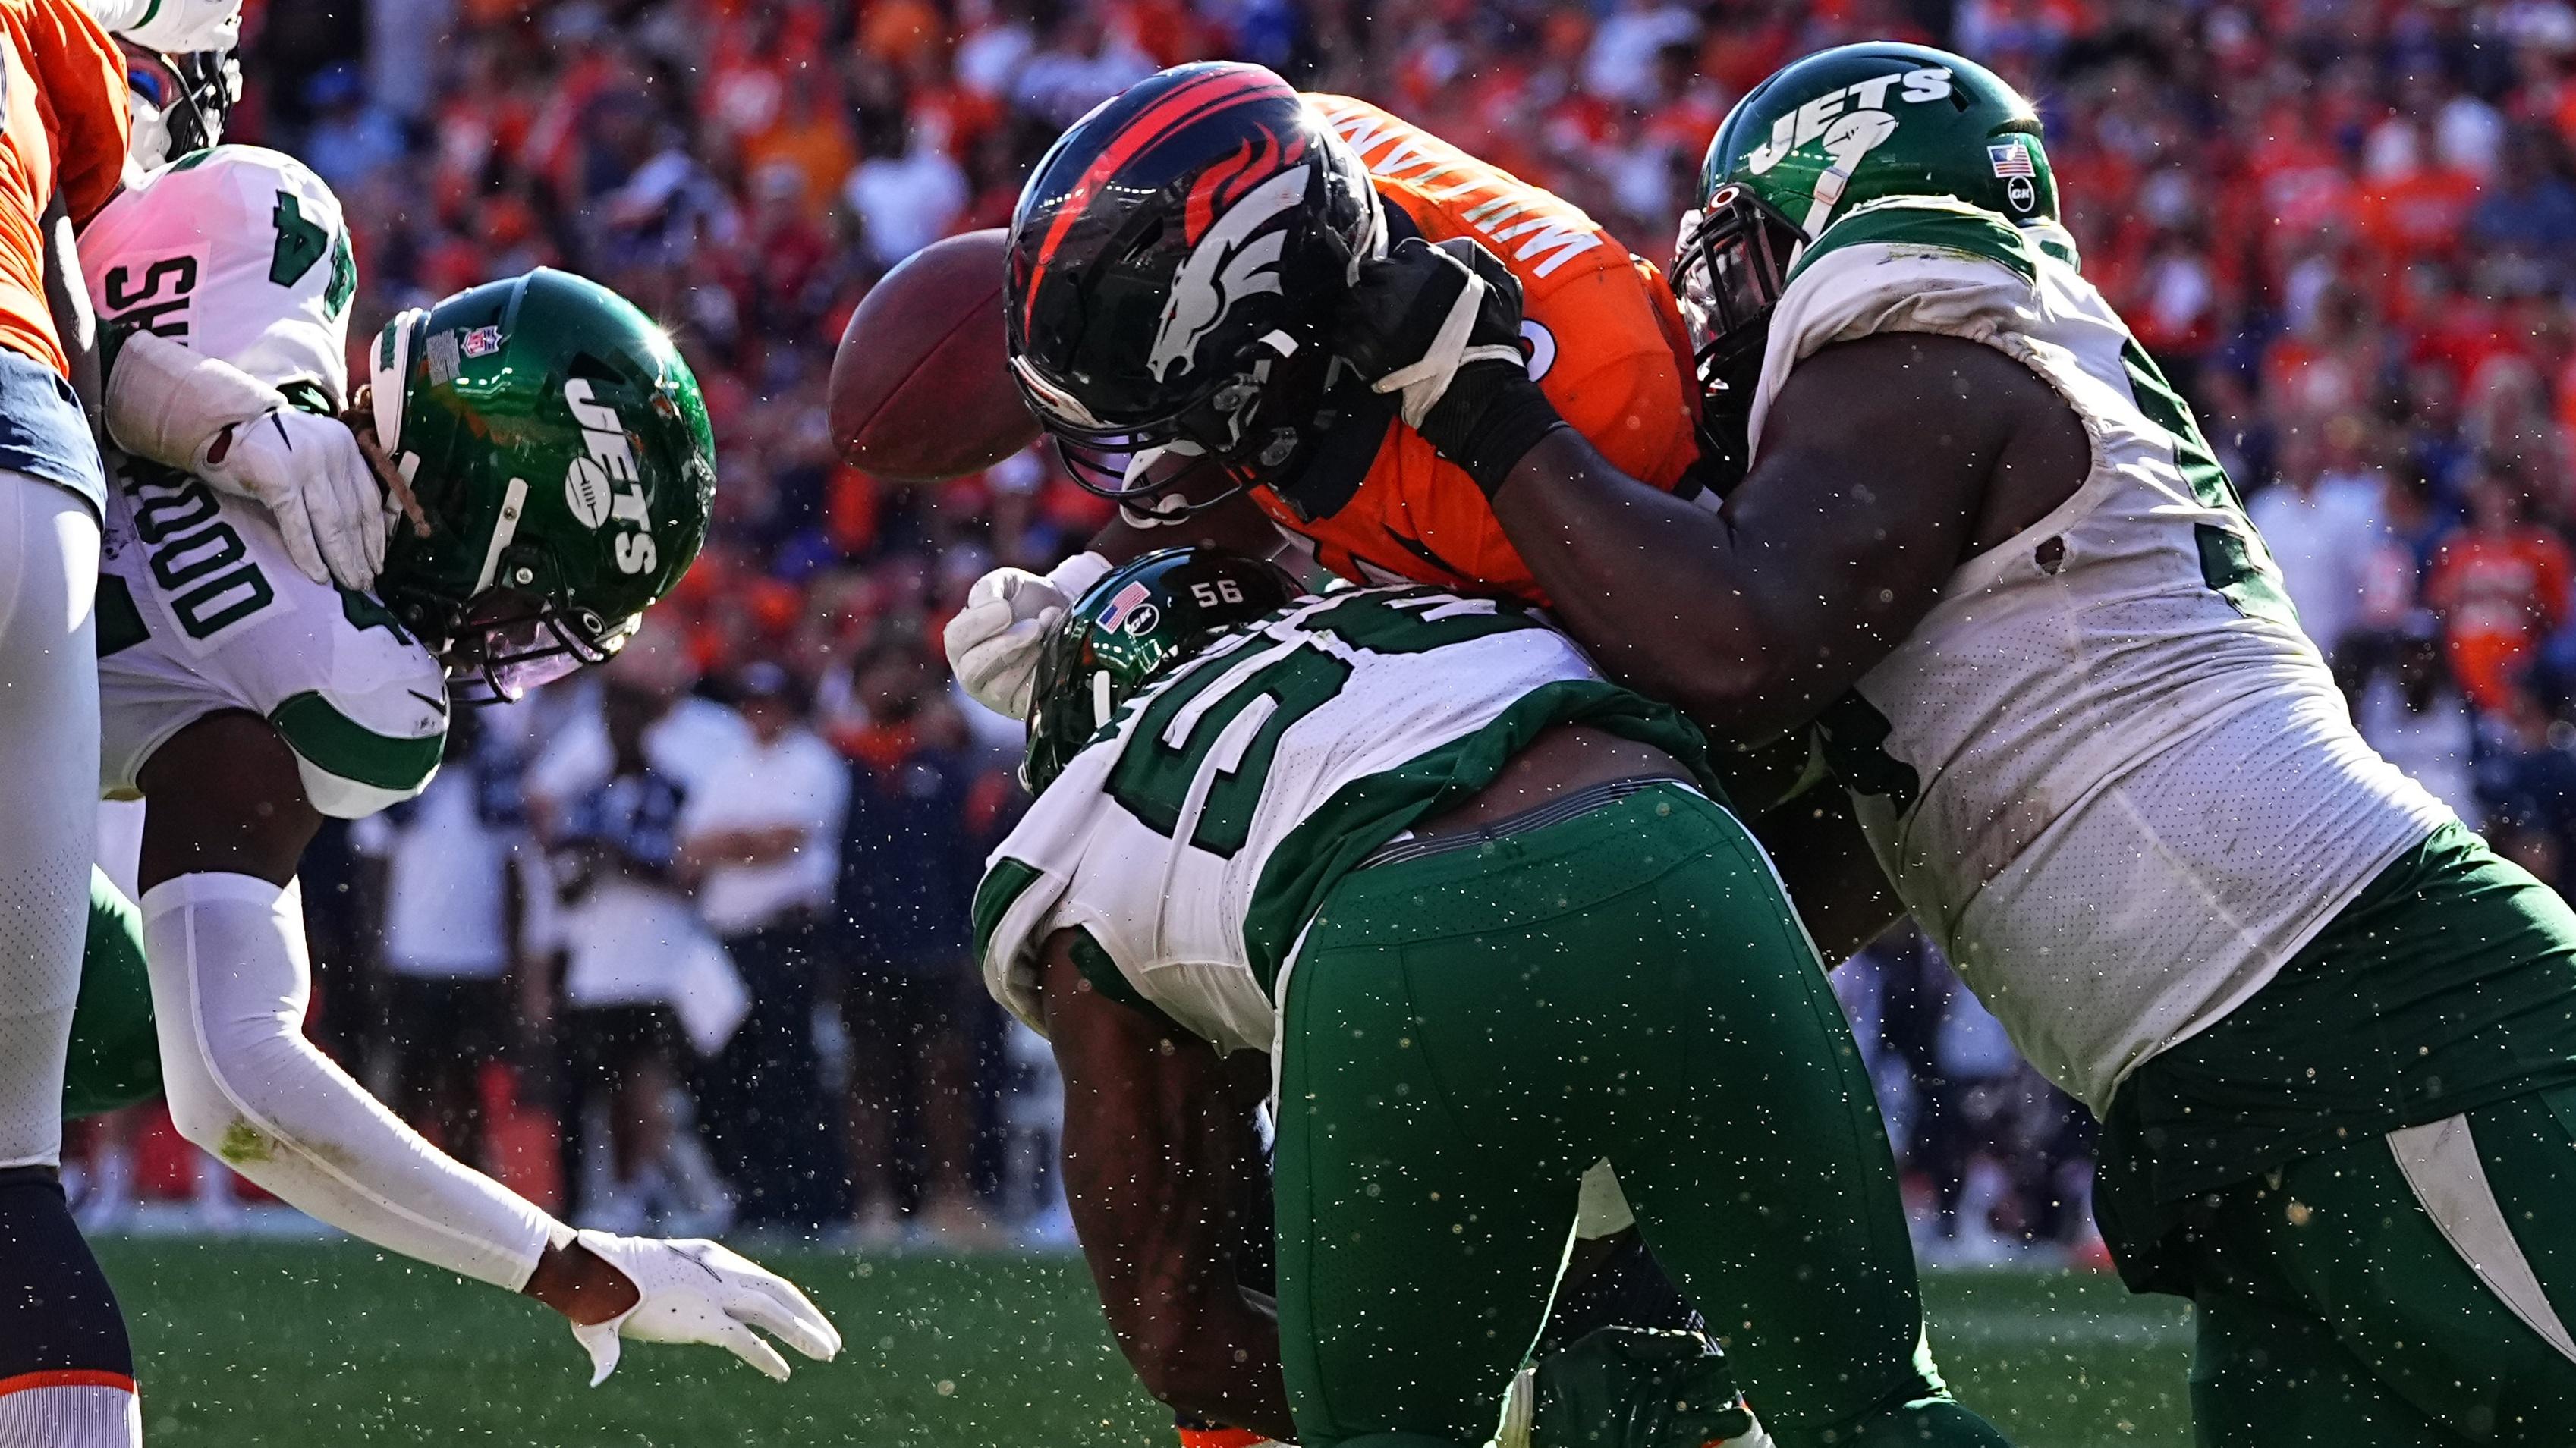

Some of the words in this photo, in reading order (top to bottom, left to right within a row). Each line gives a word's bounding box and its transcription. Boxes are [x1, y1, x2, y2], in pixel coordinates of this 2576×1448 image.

[1749, 67, 1952, 175] JETS
[565, 378, 657, 575] JETS
[1190, 579, 1244, 608] 56
